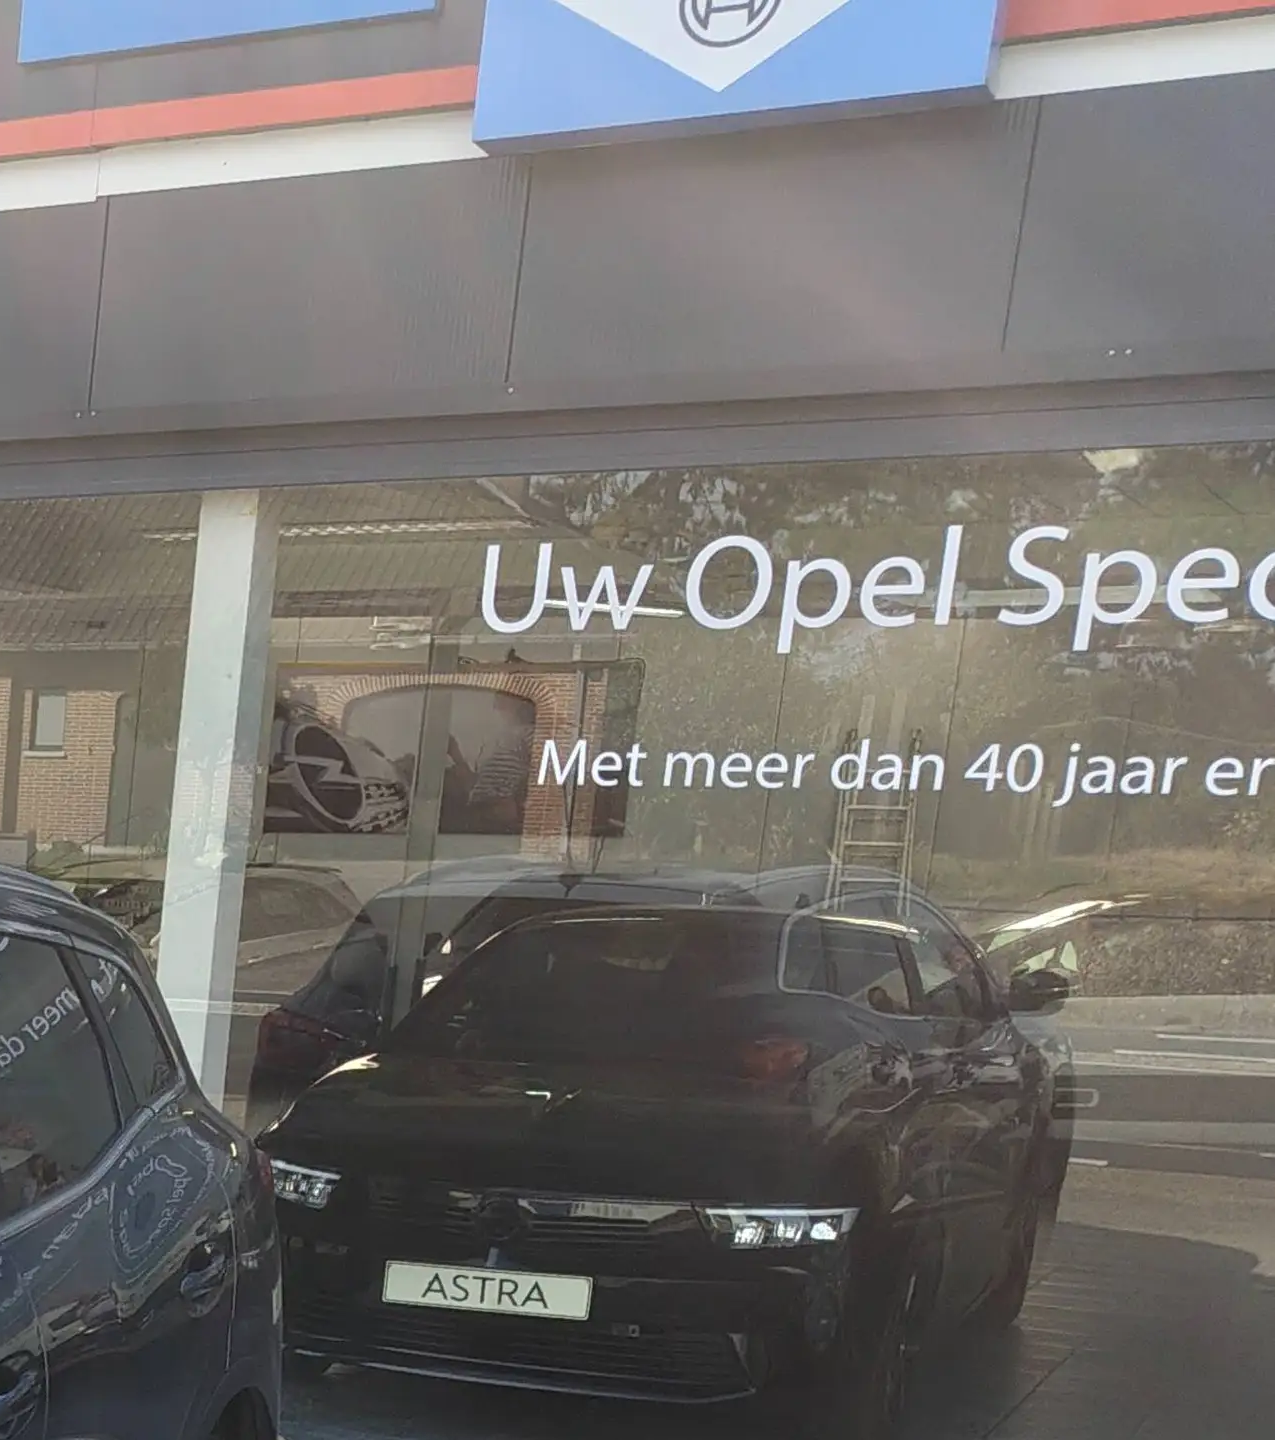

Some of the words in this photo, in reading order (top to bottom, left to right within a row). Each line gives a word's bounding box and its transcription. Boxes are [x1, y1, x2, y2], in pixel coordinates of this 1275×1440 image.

[480, 542, 654, 634] Uw
[685, 524, 964, 655] Opel
[536, 738, 647, 788] Met
[662, 747, 815, 791] meer
[830, 738, 944, 792] dan
[964, 741, 1045, 793] 40
[1051, 742, 1189, 808] jaar
[420, 1272, 550, 1310] ASTRA
